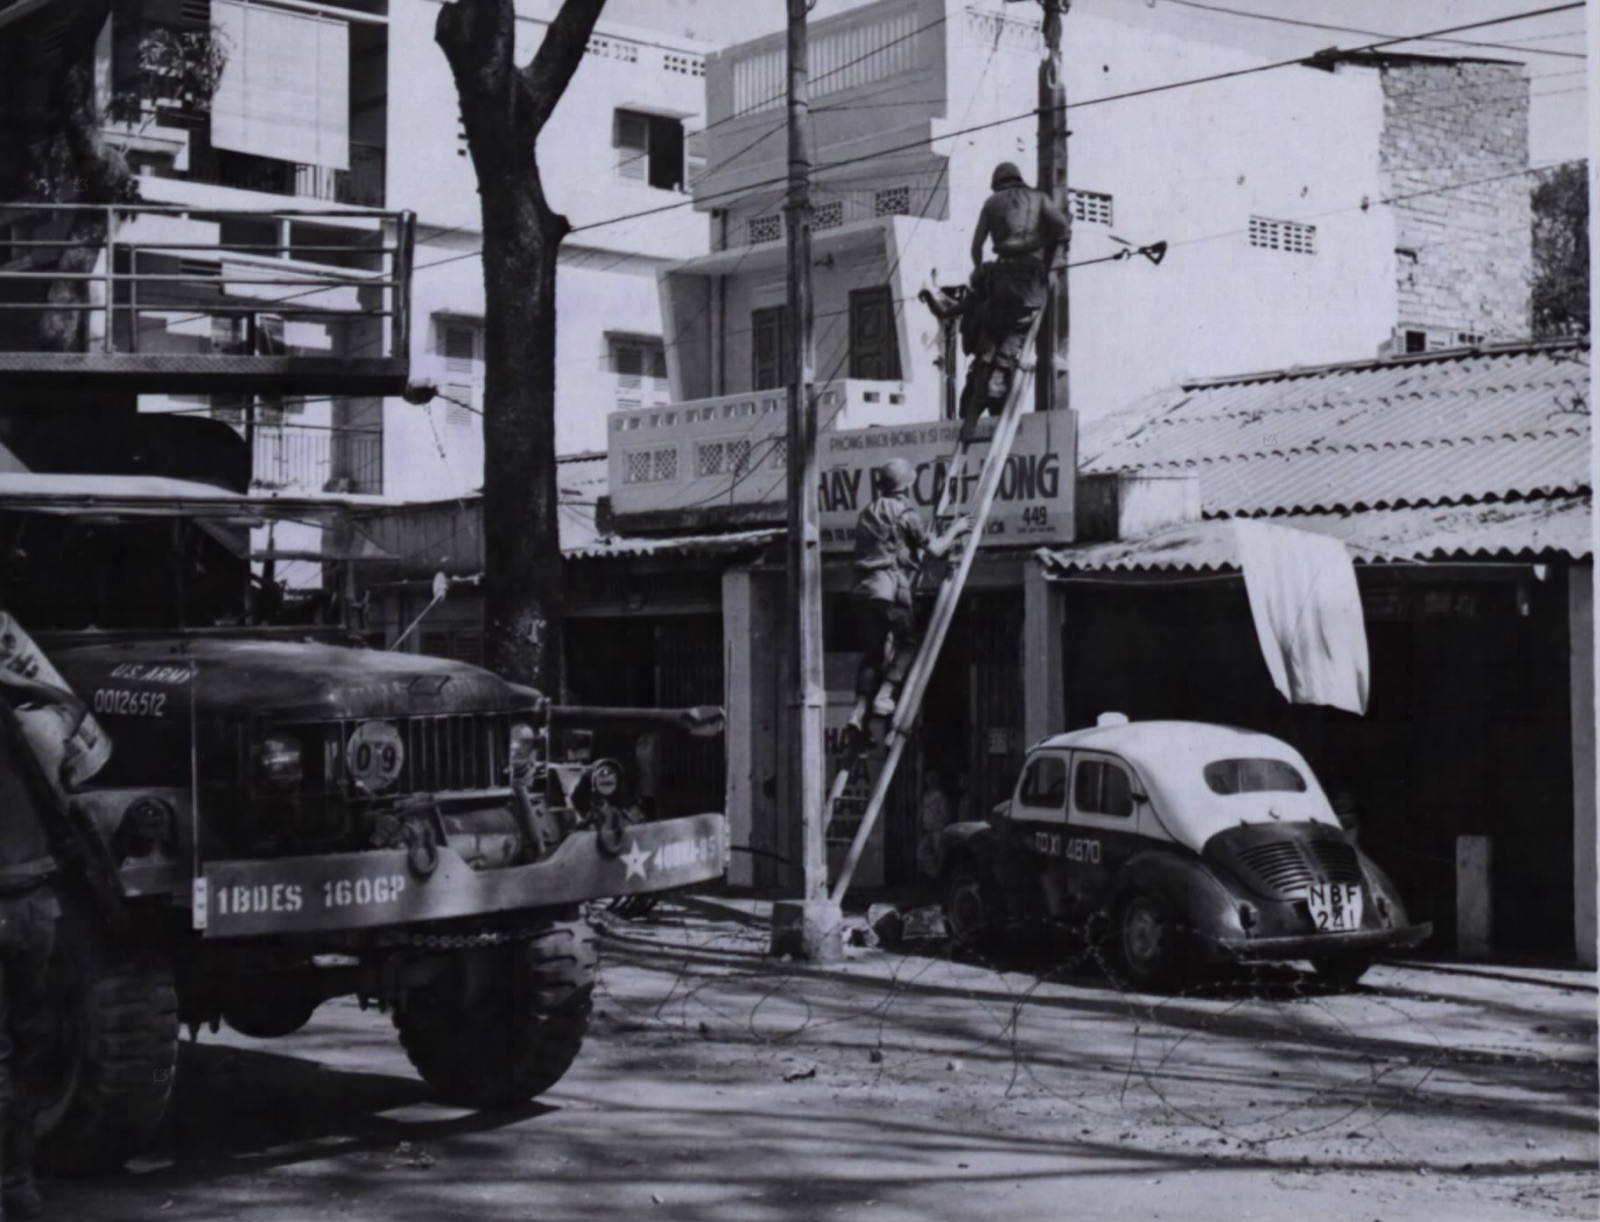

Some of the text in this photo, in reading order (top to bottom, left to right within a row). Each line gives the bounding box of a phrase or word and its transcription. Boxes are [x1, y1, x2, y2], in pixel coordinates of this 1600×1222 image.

[1022, 505, 1048, 527] 449
[140, 665, 199, 685] ARMY
[94, 688, 167, 717] 00126512
[357, 743, 396, 773] 09
[1066, 837, 1101, 864] 4870
[1310, 883, 1359, 907] NBF
